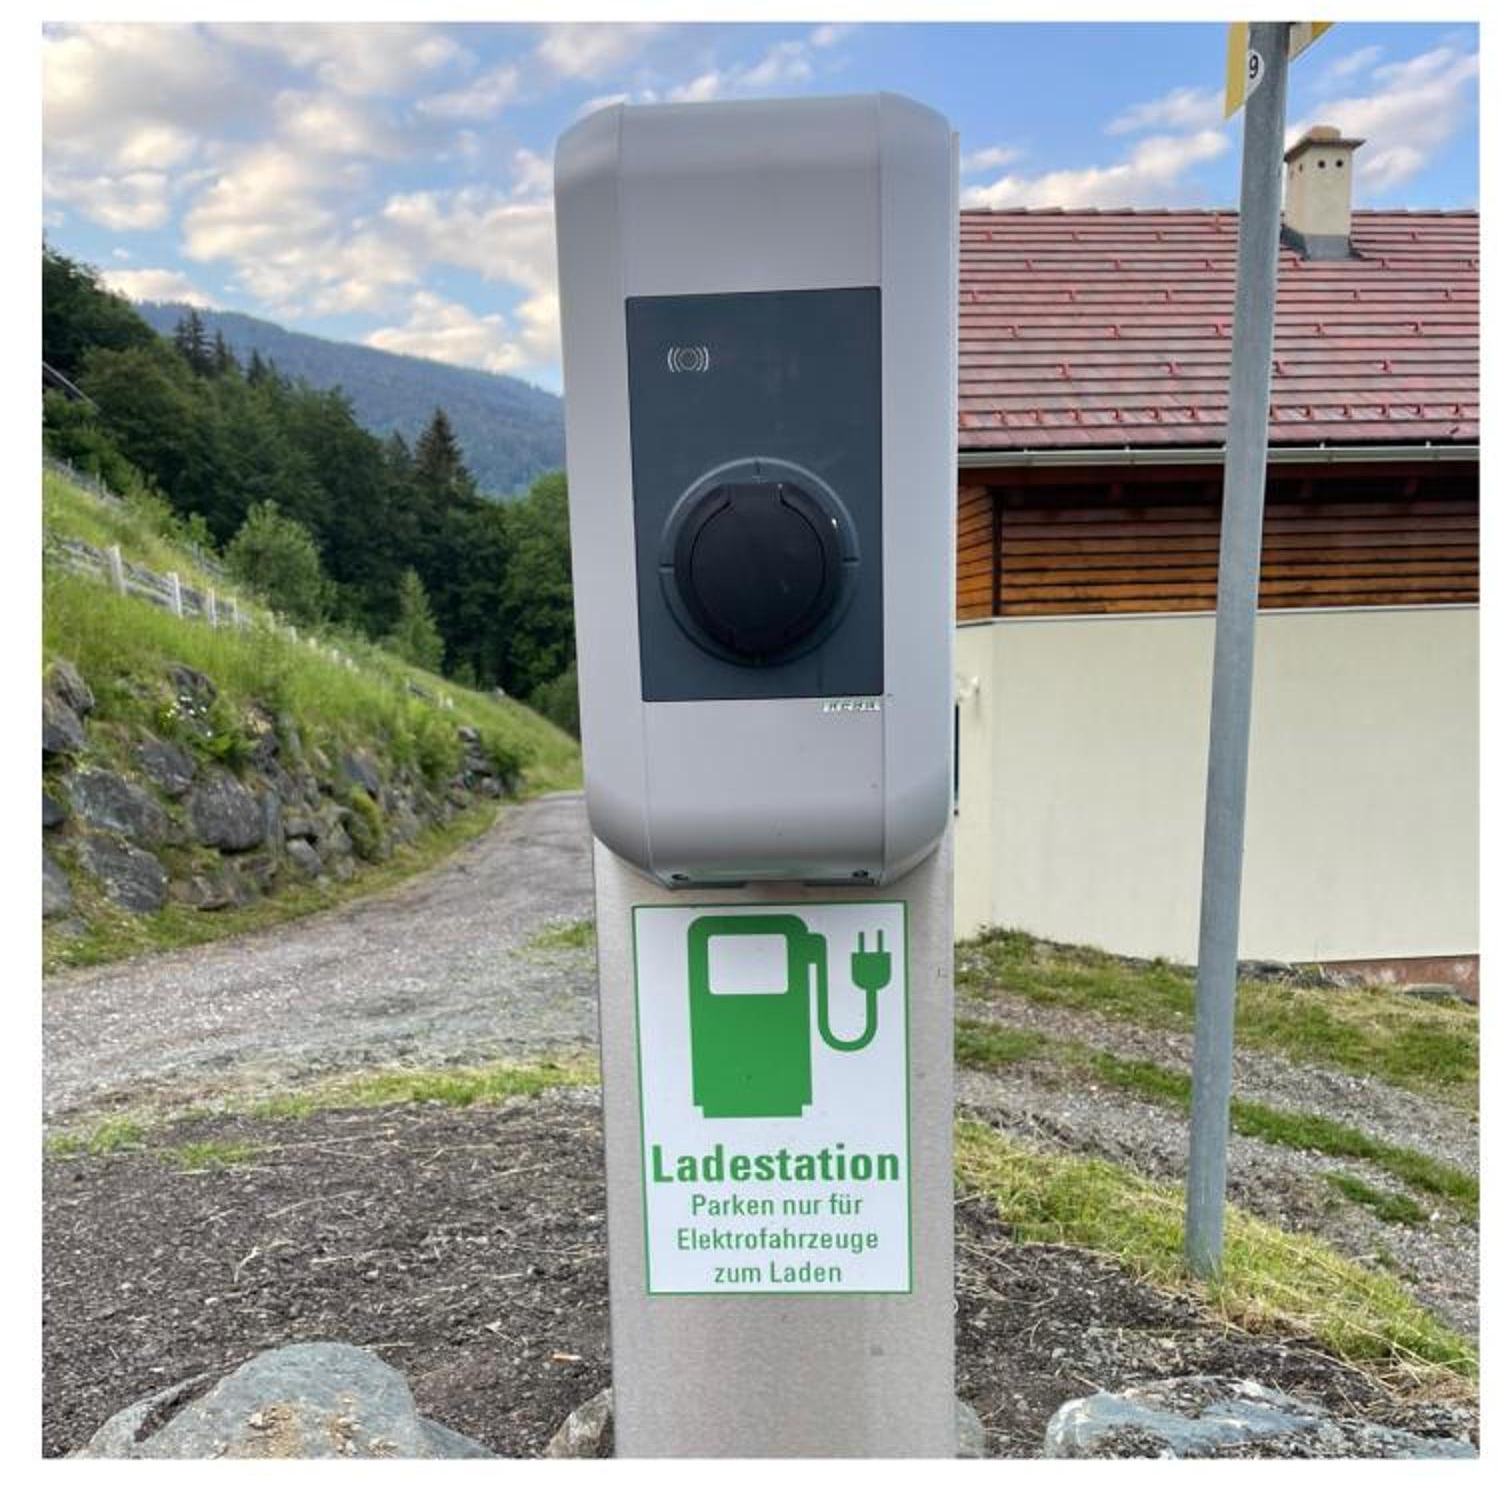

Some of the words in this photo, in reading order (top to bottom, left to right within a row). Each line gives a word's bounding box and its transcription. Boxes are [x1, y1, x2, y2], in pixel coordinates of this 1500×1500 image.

[1248, 54, 1259, 79] 9
[651, 1143, 900, 1183] Ladestation
[691, 1194, 774, 1216] Parken
[782, 1196, 821, 1216] nur
[829, 1193, 863, 1215] für
[677, 1227, 878, 1253] Elektrofahrzeuge
[713, 1263, 760, 1283] zum
[770, 1261, 841, 1283] Laden
